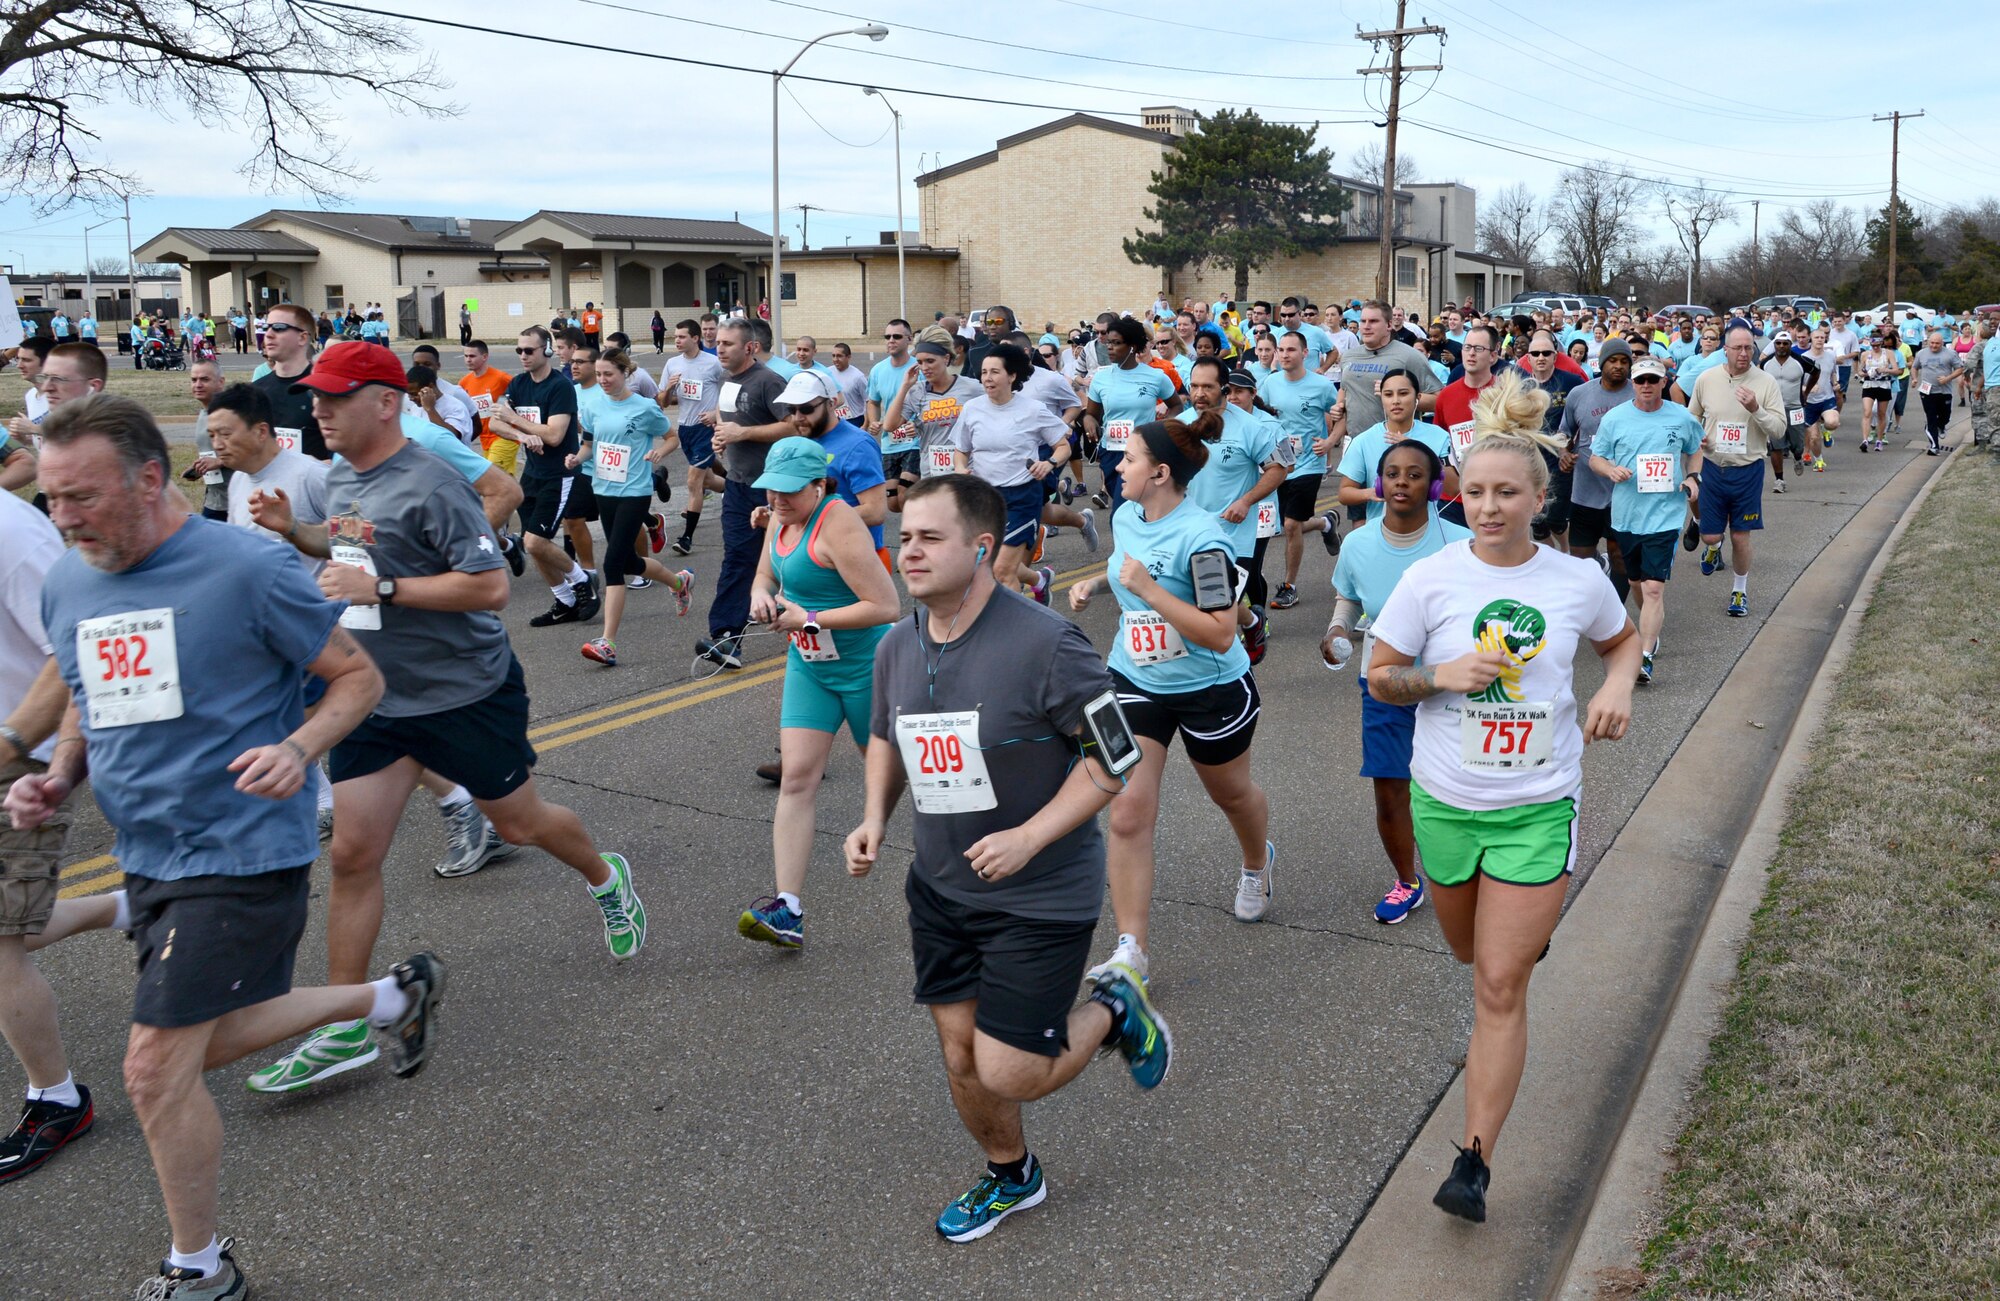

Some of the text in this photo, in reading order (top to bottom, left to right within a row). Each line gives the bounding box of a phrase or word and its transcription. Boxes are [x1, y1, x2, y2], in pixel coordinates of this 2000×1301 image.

[1348, 362, 1389, 375] FOOTBALL
[684, 384, 698, 395] 515
[930, 397, 957, 409] RED
[1110, 426, 1129, 439] 883
[1722, 428, 1741, 441] 769
[601, 450, 621, 467] 750
[933, 453, 951, 466] 786
[1645, 461, 1667, 477] 572
[1131, 625, 1167, 653] 837
[97, 635, 152, 681] 582
[1466, 710, 1547, 720] 5K Fun Run & 2K Walk
[1481, 720, 1533, 754] 757
[915, 735, 963, 774] 209
